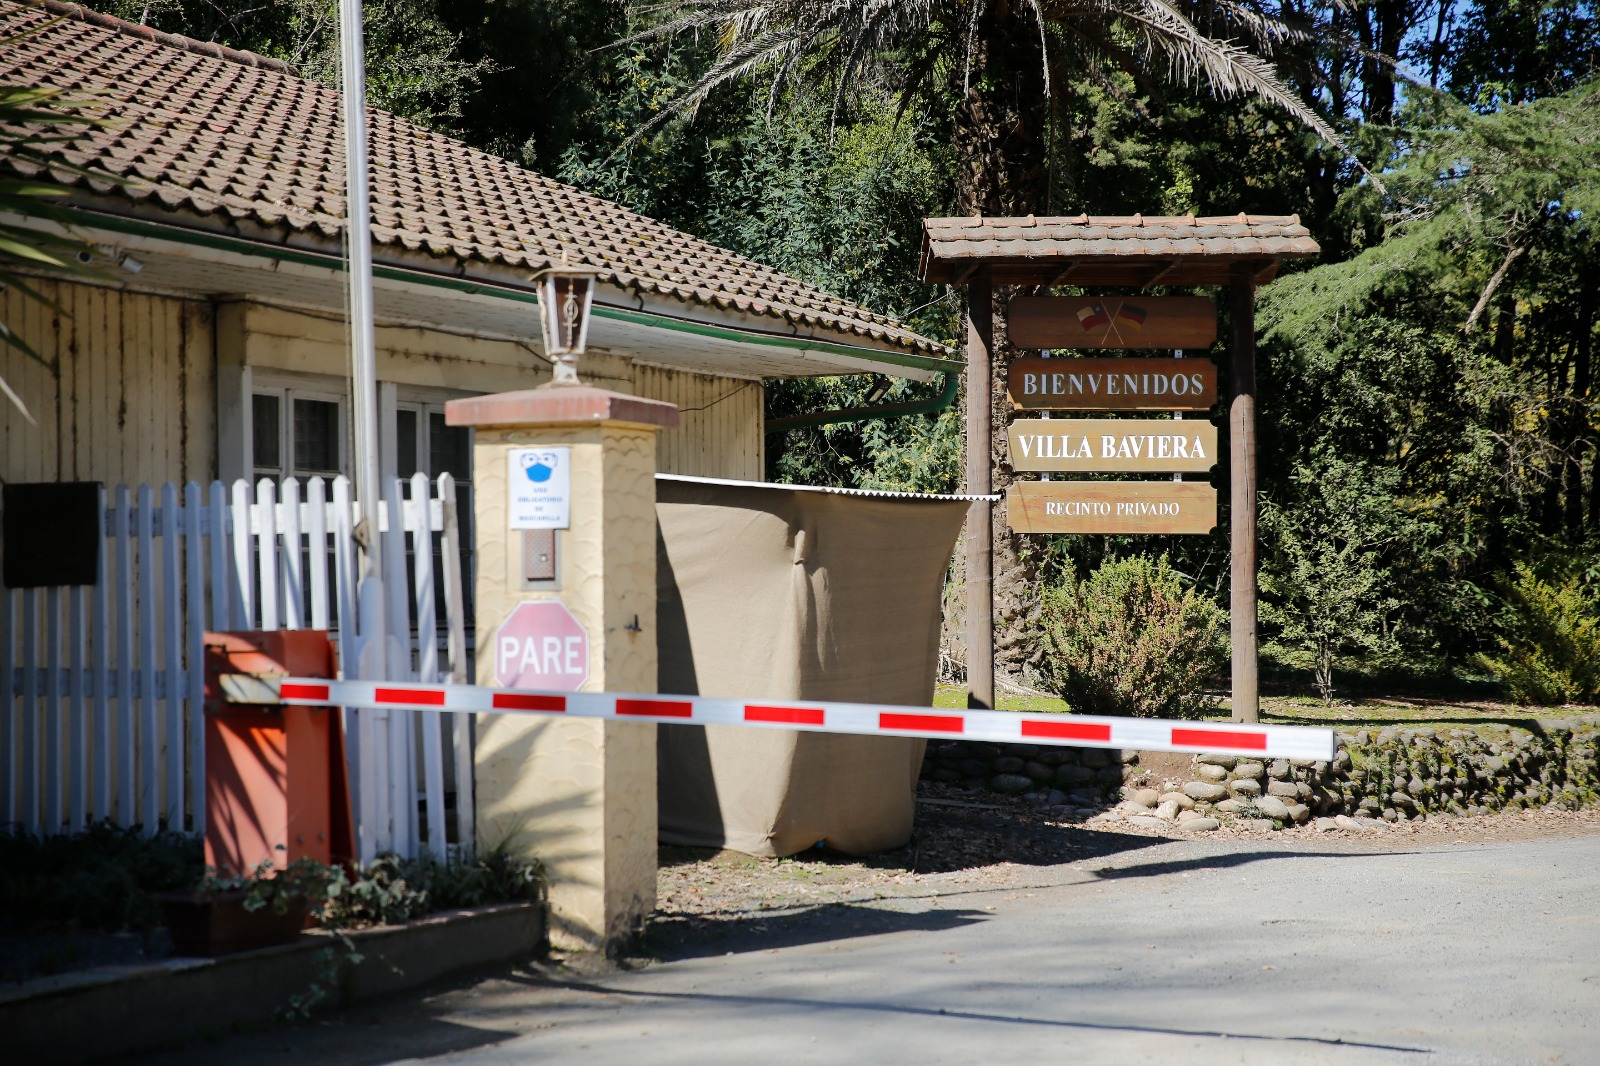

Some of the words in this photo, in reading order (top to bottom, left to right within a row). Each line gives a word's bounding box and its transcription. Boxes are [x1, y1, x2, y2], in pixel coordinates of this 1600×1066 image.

[1023, 373, 1204, 396] BIENVENIDOS
[1018, 434, 1094, 458] VILLA
[1101, 434, 1206, 458] BAVIERA
[1046, 502, 1111, 516] RECINTO
[1116, 502, 1180, 516] PRIVADO
[500, 636, 583, 674] PARE
